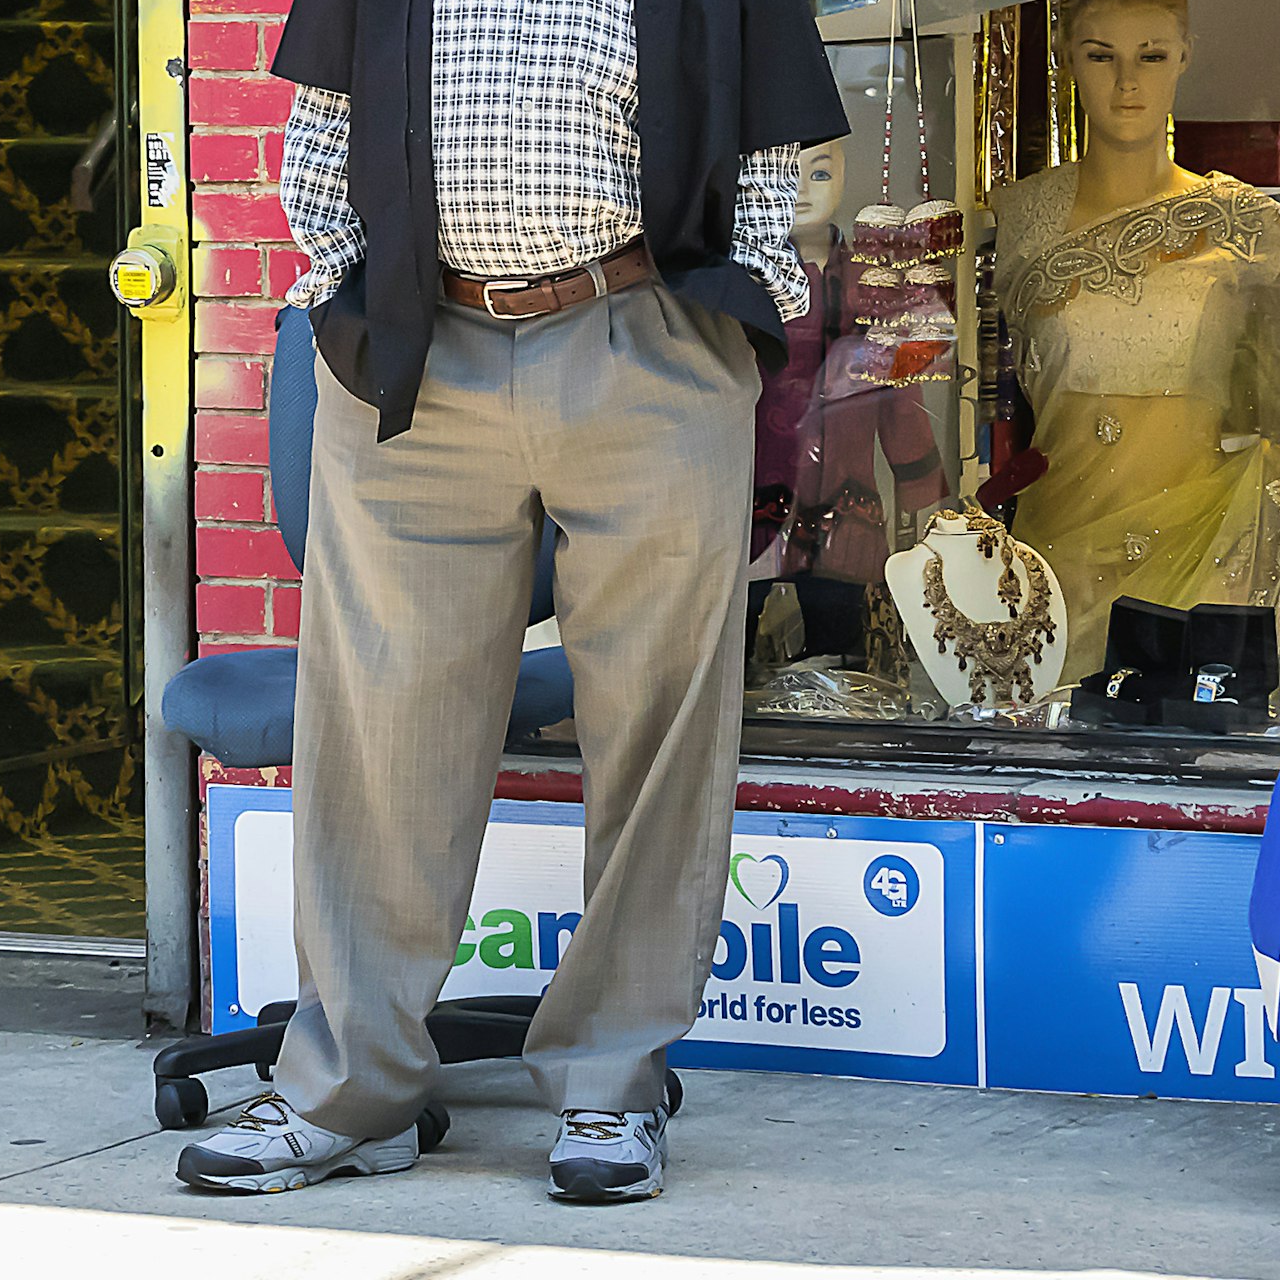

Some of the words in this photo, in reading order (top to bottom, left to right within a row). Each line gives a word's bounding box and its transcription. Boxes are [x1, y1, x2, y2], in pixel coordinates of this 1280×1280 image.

[871, 867, 908, 901] 4G
[695, 993, 747, 1021] orld
[754, 995, 798, 1023] for
[802, 997, 862, 1029] less
